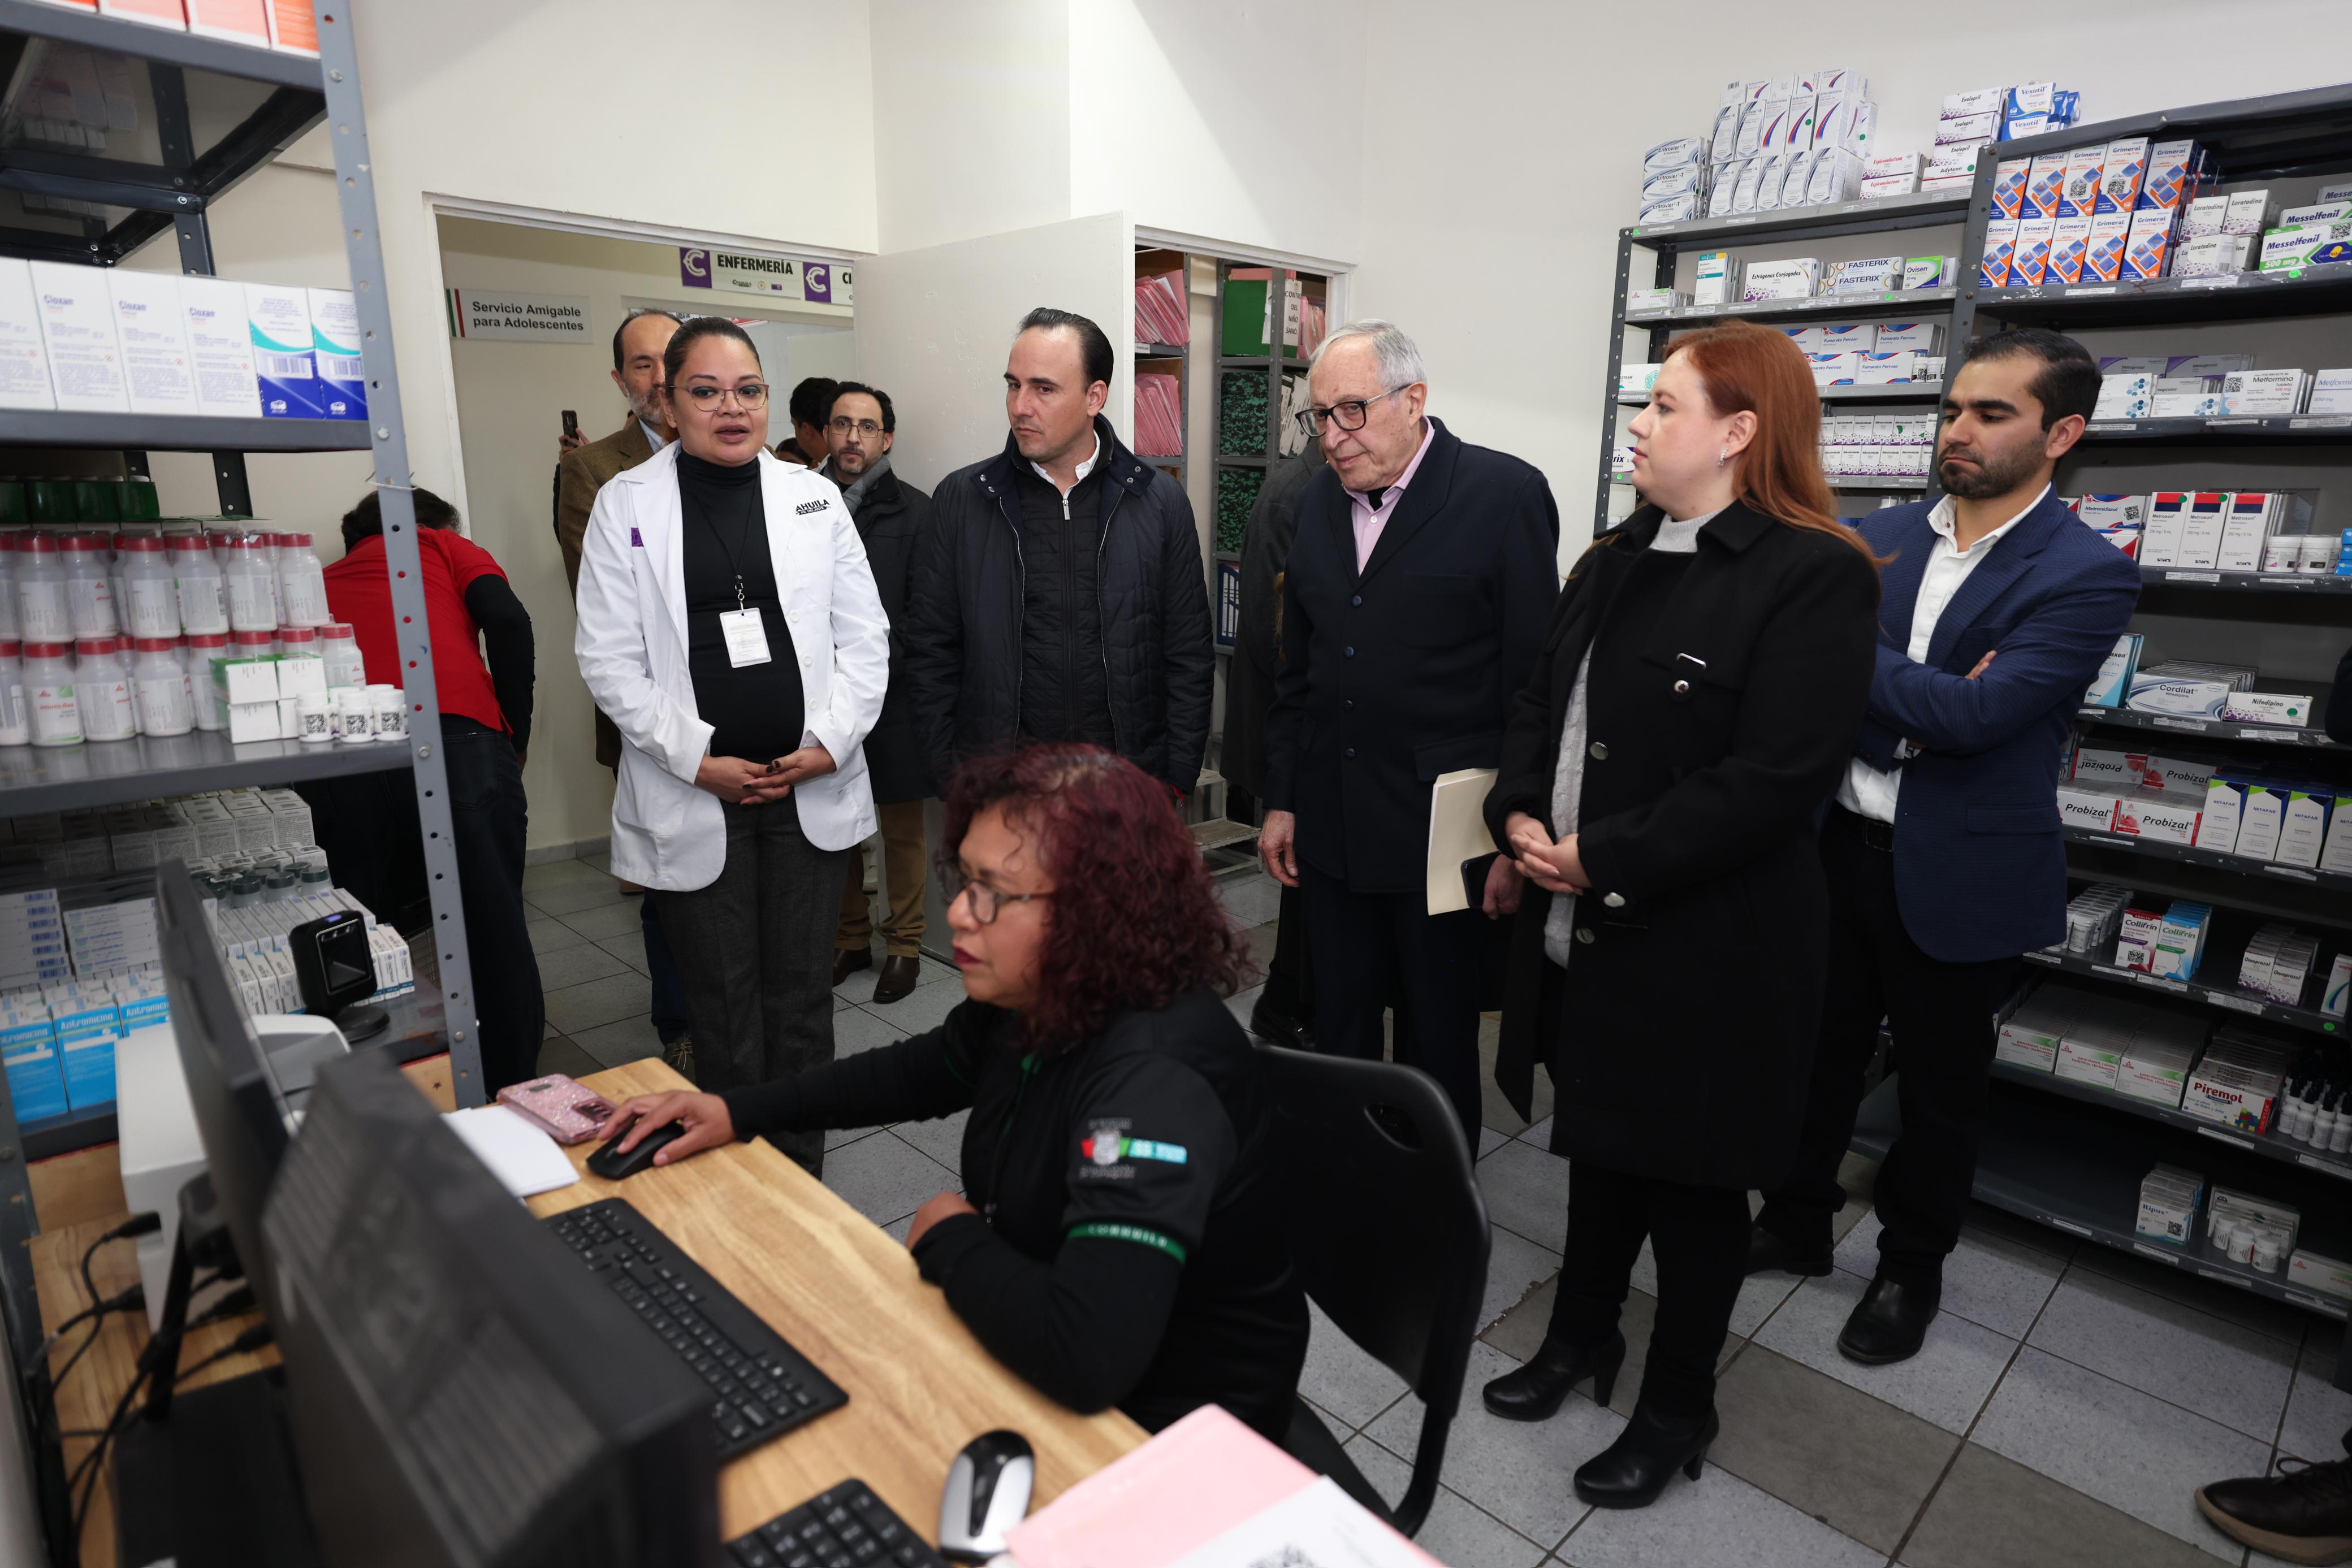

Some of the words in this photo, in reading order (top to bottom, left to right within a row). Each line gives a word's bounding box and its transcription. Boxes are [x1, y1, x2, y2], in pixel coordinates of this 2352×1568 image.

[1873, 156, 1903, 164] Espironolactona
[717, 254, 793, 275] ENFERMERÍA
[2264, 259, 2281, 268] 500
[2282, 258, 2297, 266] mg
[1776, 270, 1801, 279] Conjugados
[473, 301, 522, 314] Servicio
[526, 305, 581, 318] Amigable
[473, 318, 500, 328] para
[504, 318, 583, 331] Adolescentes
[2251, 698, 2284, 707] Nifedipino
[2125, 919, 2158, 930] Collifrin
[2163, 927, 2195, 938] Collifrin
[2245, 957, 2271, 967] Omeprazol
[2274, 970, 2301, 980] Omeprazol
[60, 1013, 114, 1030] Azitromicina
[2194, 1082, 2242, 1103] Piremol
